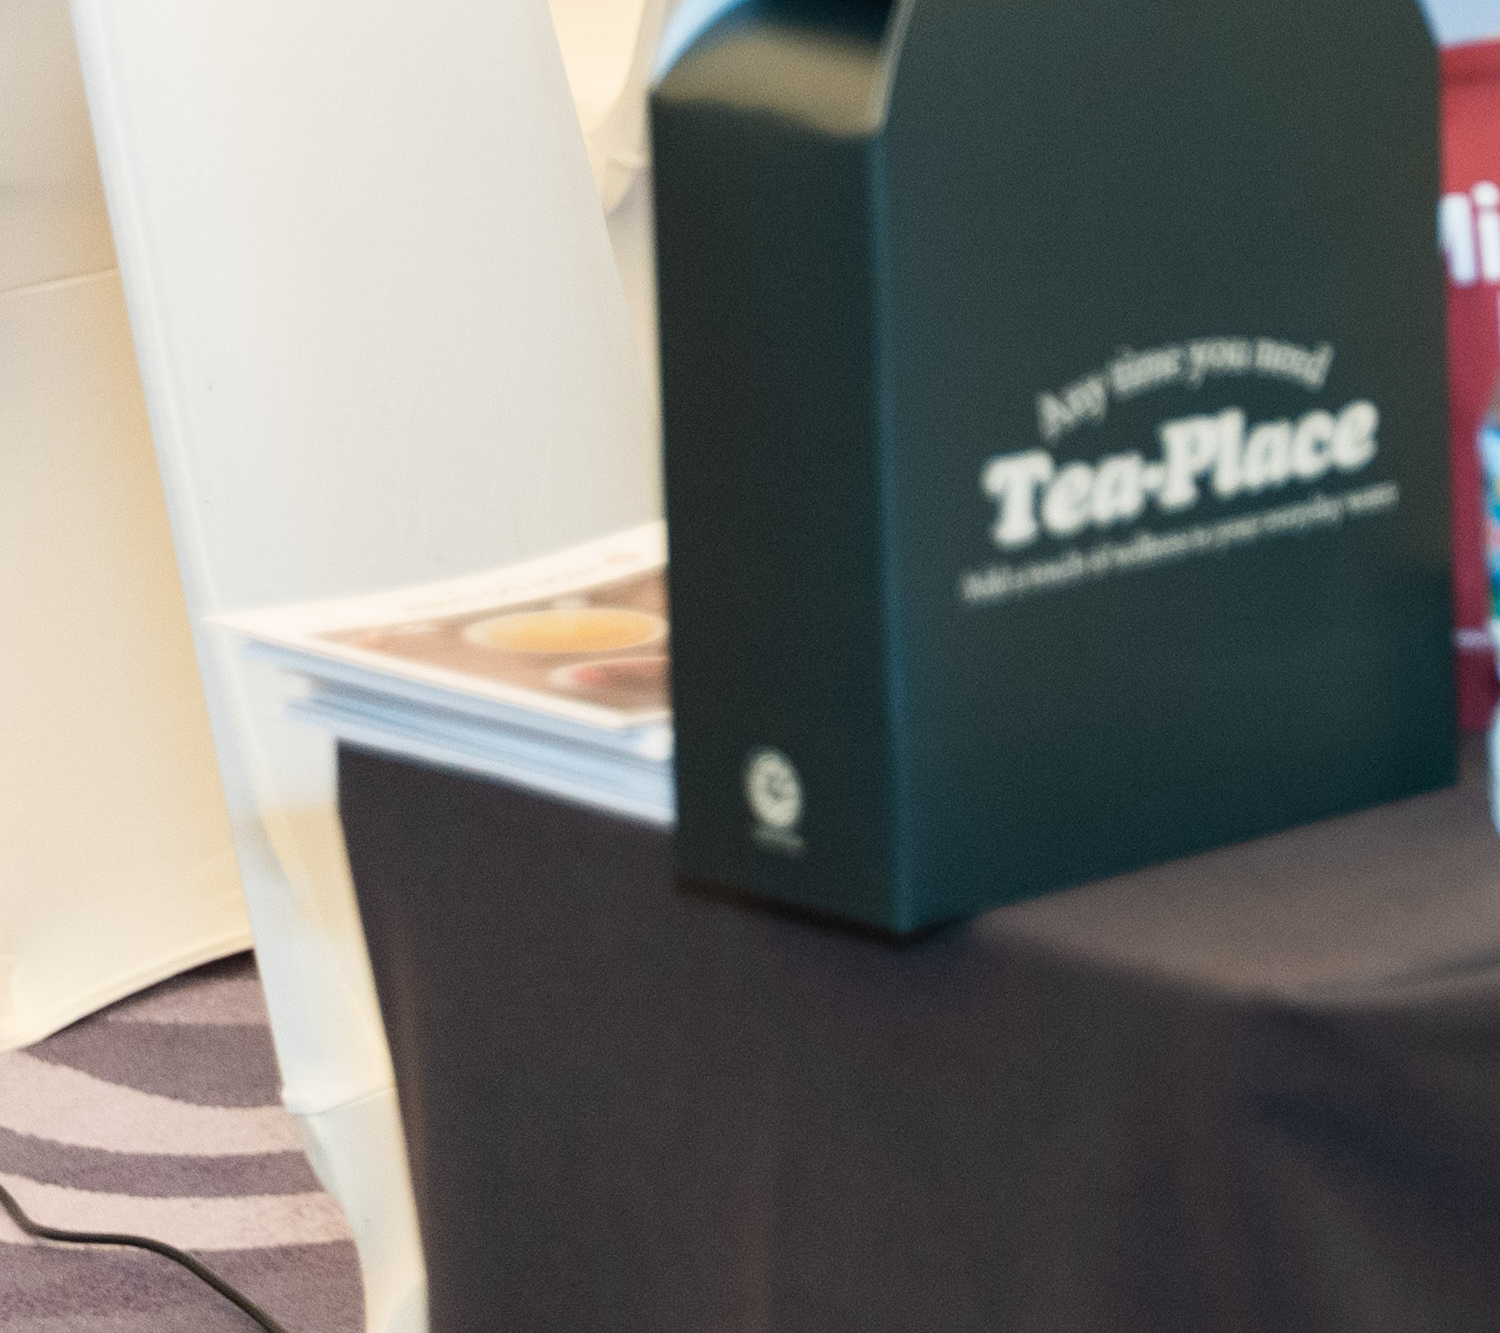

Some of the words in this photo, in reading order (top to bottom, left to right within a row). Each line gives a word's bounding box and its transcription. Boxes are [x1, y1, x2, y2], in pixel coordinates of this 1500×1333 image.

[1037, 374, 1108, 440] Any
[1109, 345, 1181, 398] time
[1188, 335, 1252, 388] you
[1255, 336, 1335, 390] need
